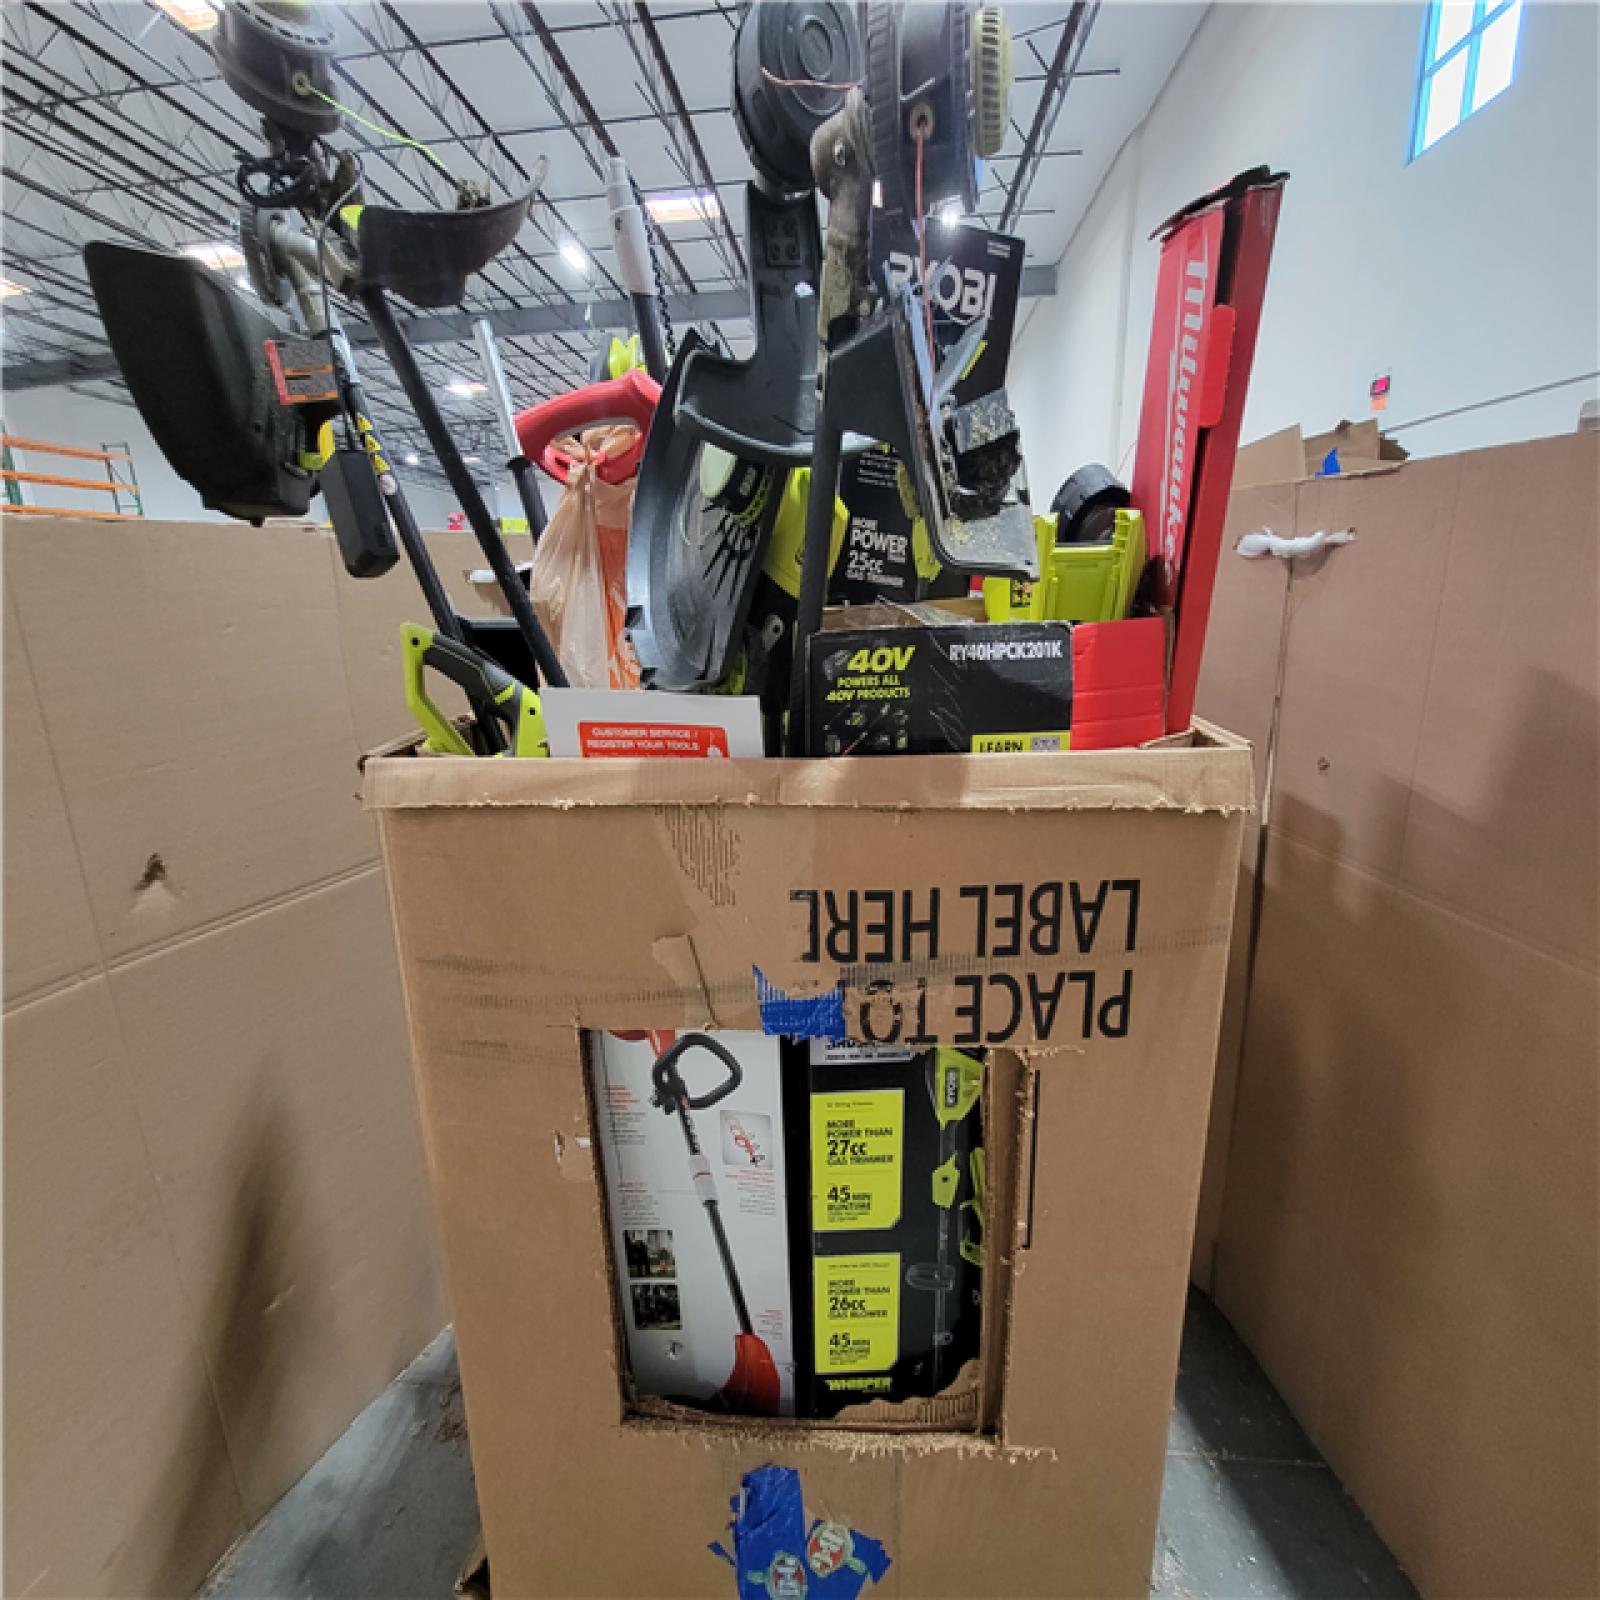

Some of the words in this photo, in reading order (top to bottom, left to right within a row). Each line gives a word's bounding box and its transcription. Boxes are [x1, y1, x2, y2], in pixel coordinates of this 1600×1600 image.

[888, 250, 997, 322] RYOBI
[849, 529, 908, 552] POWER
[847, 645, 916, 673] 40V
[837, 675, 880, 688] POWERS
[882, 674, 901, 686] ALL
[825, 688, 855, 701] 40V
[856, 687, 911, 700] PRODUCTS
[592, 727, 647, 738] CUSTOMER
[649, 729, 691, 739] SERVICE
[586, 739, 635, 749] REGISTER
[637, 740, 665, 749] YOUR
[667, 741, 699, 751] TOOLS
[979, 738, 1024, 752] LEARN
[959, 878, 1141, 958] LABEL
[858, 976, 938, 1045] TO
[953, 969, 1134, 1045] PLACE
[826, 1119, 856, 1128] MORE
[826, 1128, 862, 1138] POWER
[864, 1127, 894, 1136] THAN
[826, 1156, 849, 1166] GAS
[850, 1154, 895, 1164] TRIMMER
[826, 1185, 850, 1203] 45
[826, 1202, 872, 1212] RUNTIME
[827, 1279, 856, 1287] MORE
[827, 1286, 861, 1296] POWER
[864, 1285, 891, 1295] THAN
[828, 1310, 849, 1320] GAS
[849, 1309, 889, 1319] BLOWER
[828, 1332, 850, 1347] 45
